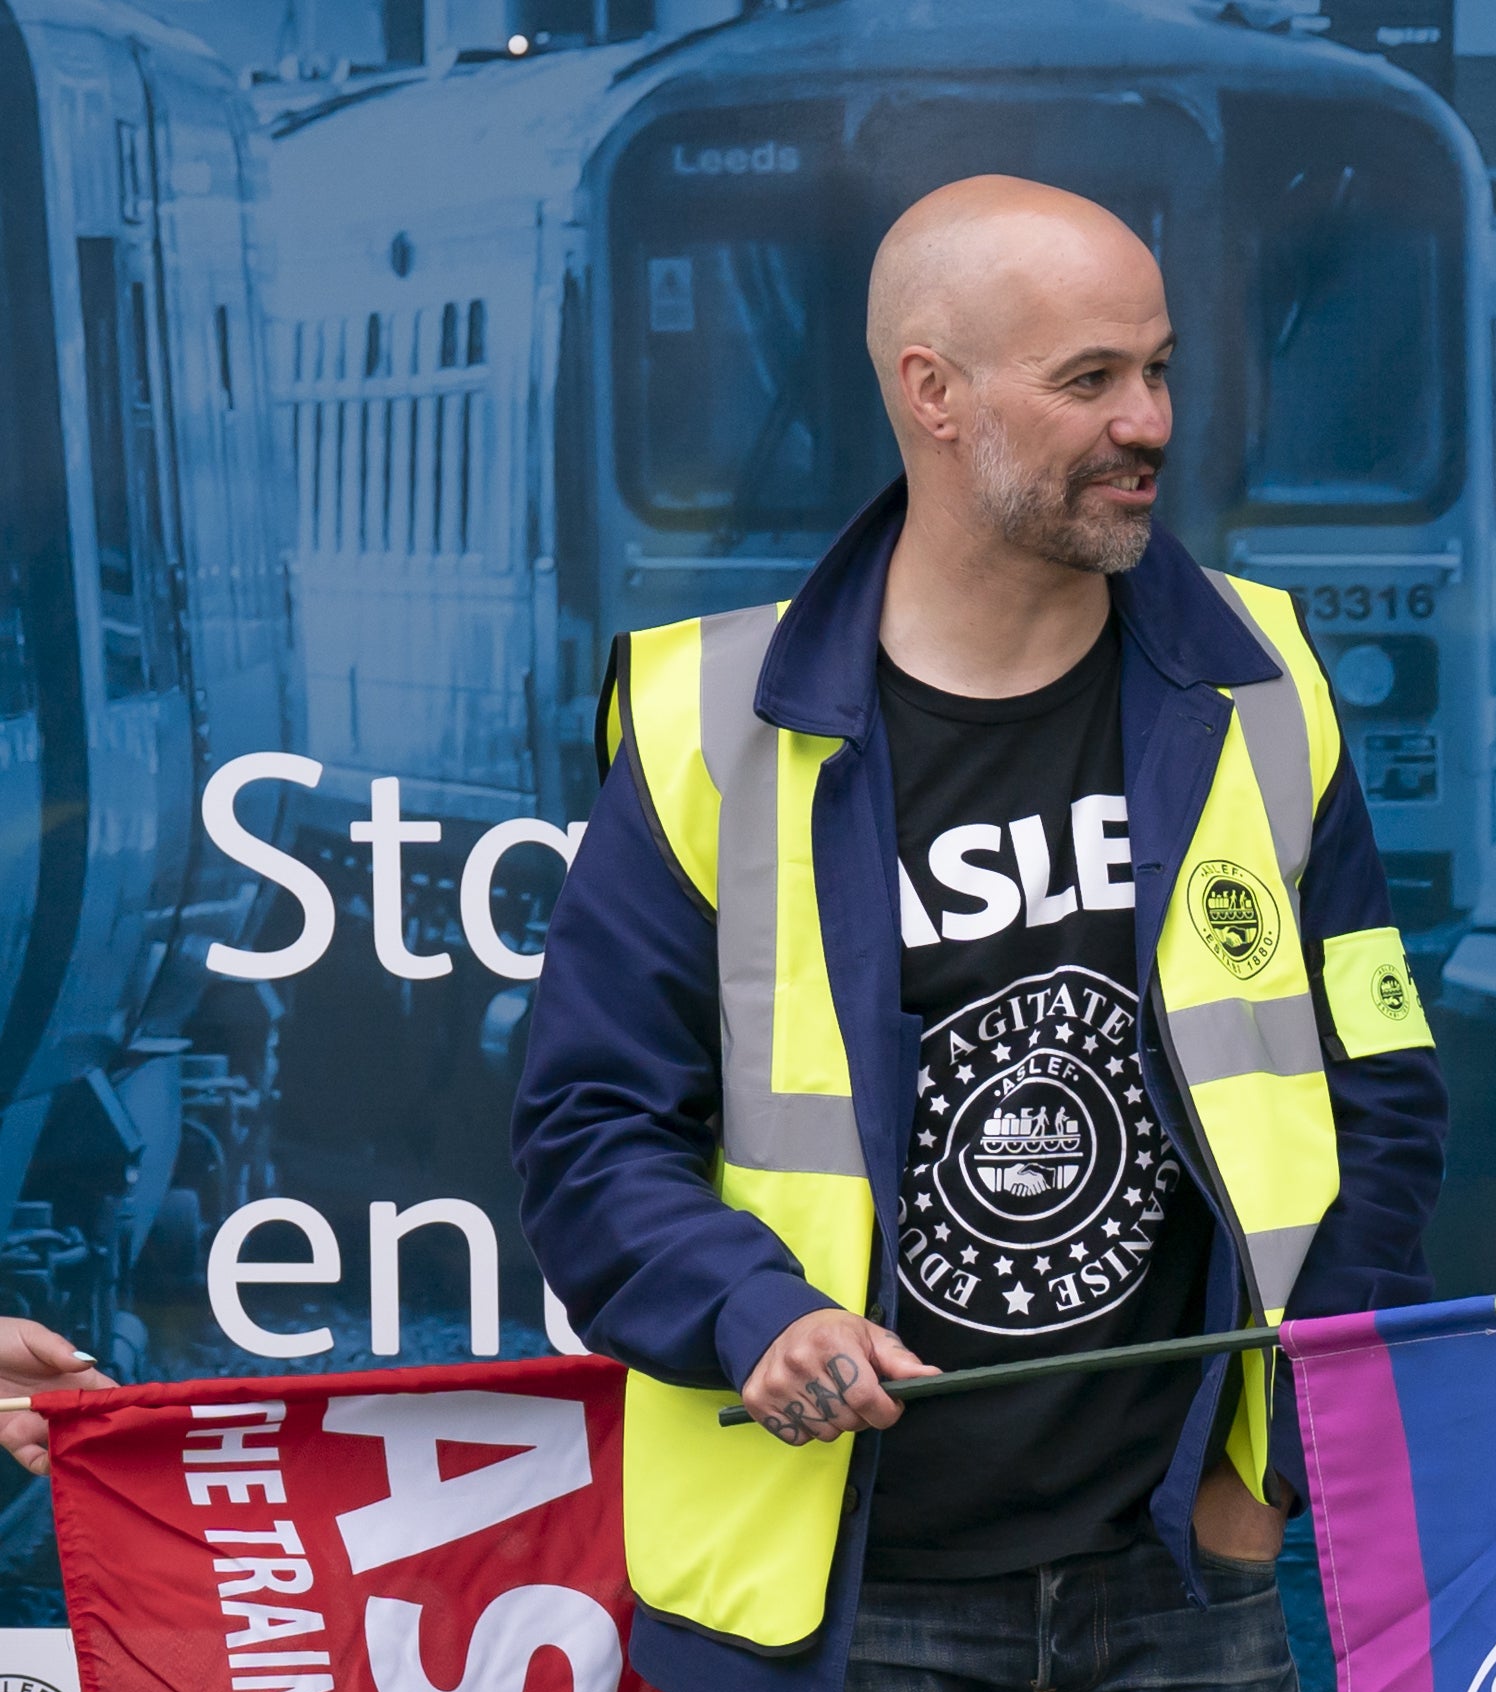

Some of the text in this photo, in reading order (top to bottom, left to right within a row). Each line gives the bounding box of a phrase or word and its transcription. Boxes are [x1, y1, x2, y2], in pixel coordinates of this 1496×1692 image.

[673, 142, 802, 176] Leeds
[1203, 862, 1240, 877] ASLEF
[1247, 937, 1274, 971] 1880
[948, 983, 1135, 1066] AGITATE
[1002, 1058, 1077, 1095] ASLEF
[764, 1353, 859, 1445] BRAD
[182, 1401, 288, 1505] THE
